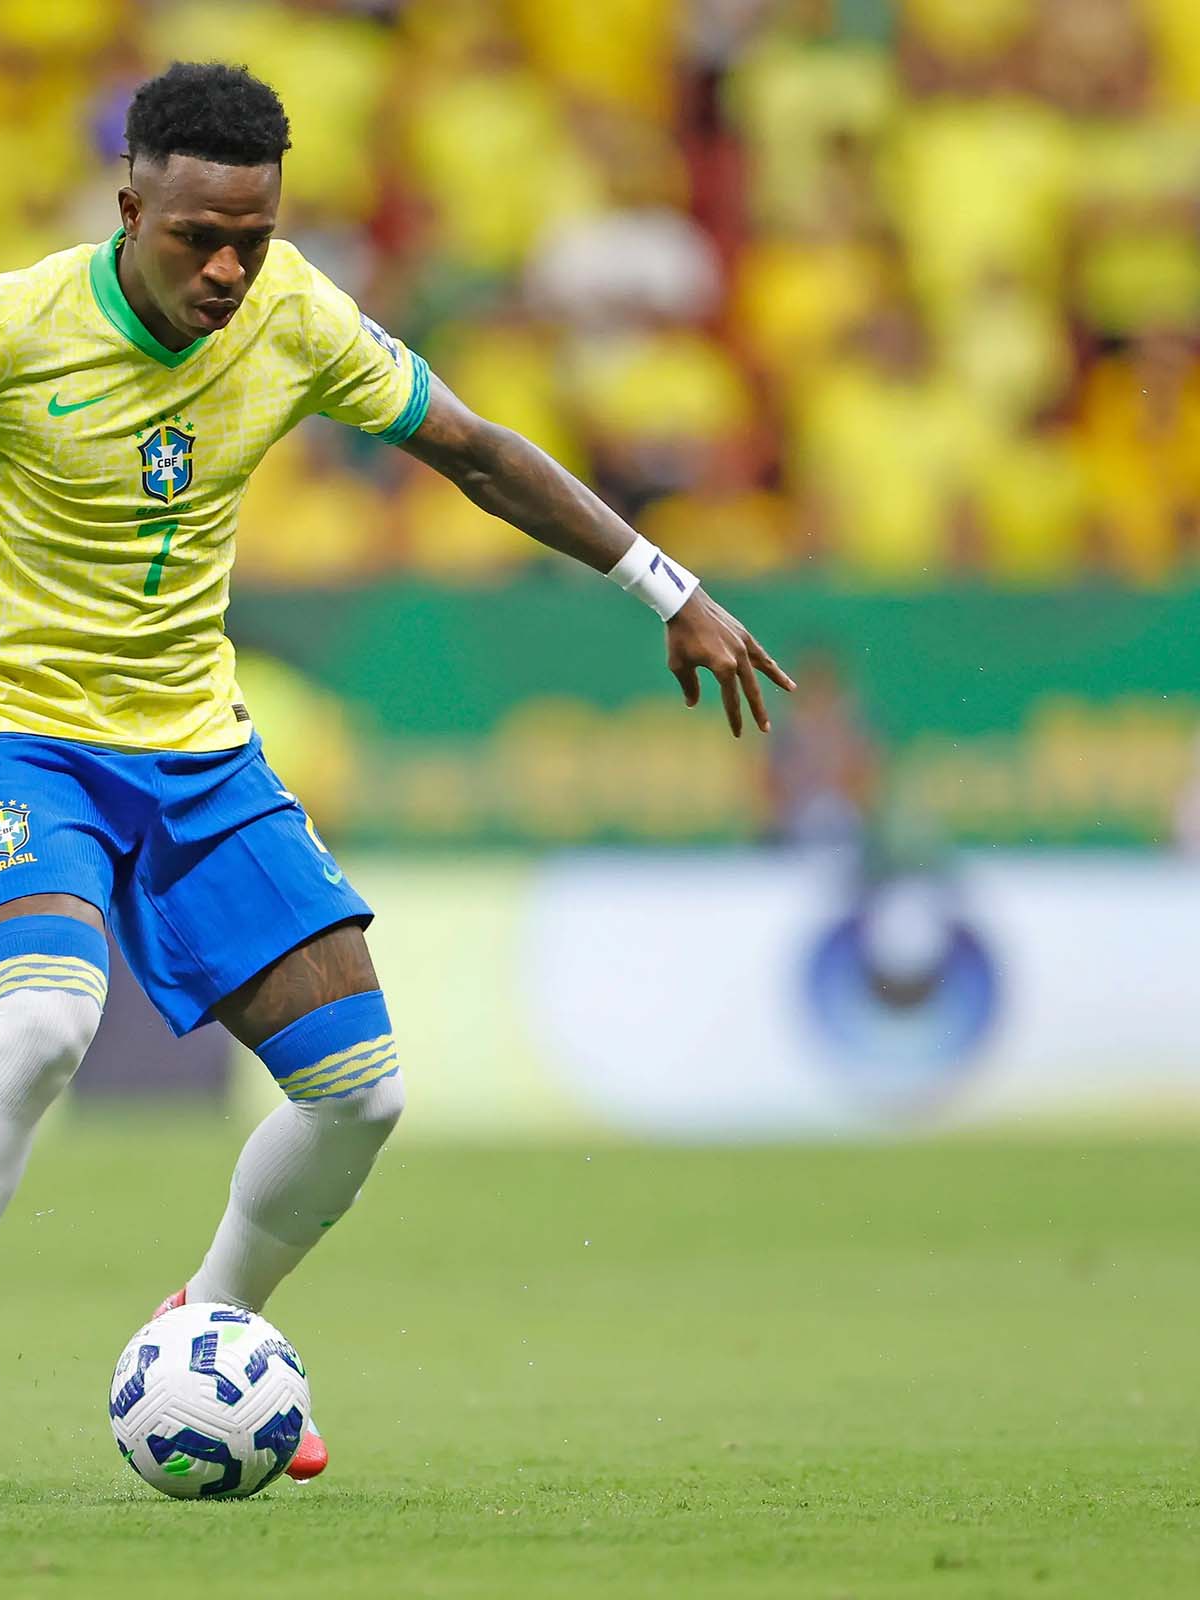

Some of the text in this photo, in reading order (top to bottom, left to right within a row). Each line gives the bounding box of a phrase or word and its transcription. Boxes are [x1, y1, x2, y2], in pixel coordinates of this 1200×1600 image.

[157, 457, 178, 468] CBF
[137, 519, 179, 596] 7
[650, 554, 686, 593] 7
